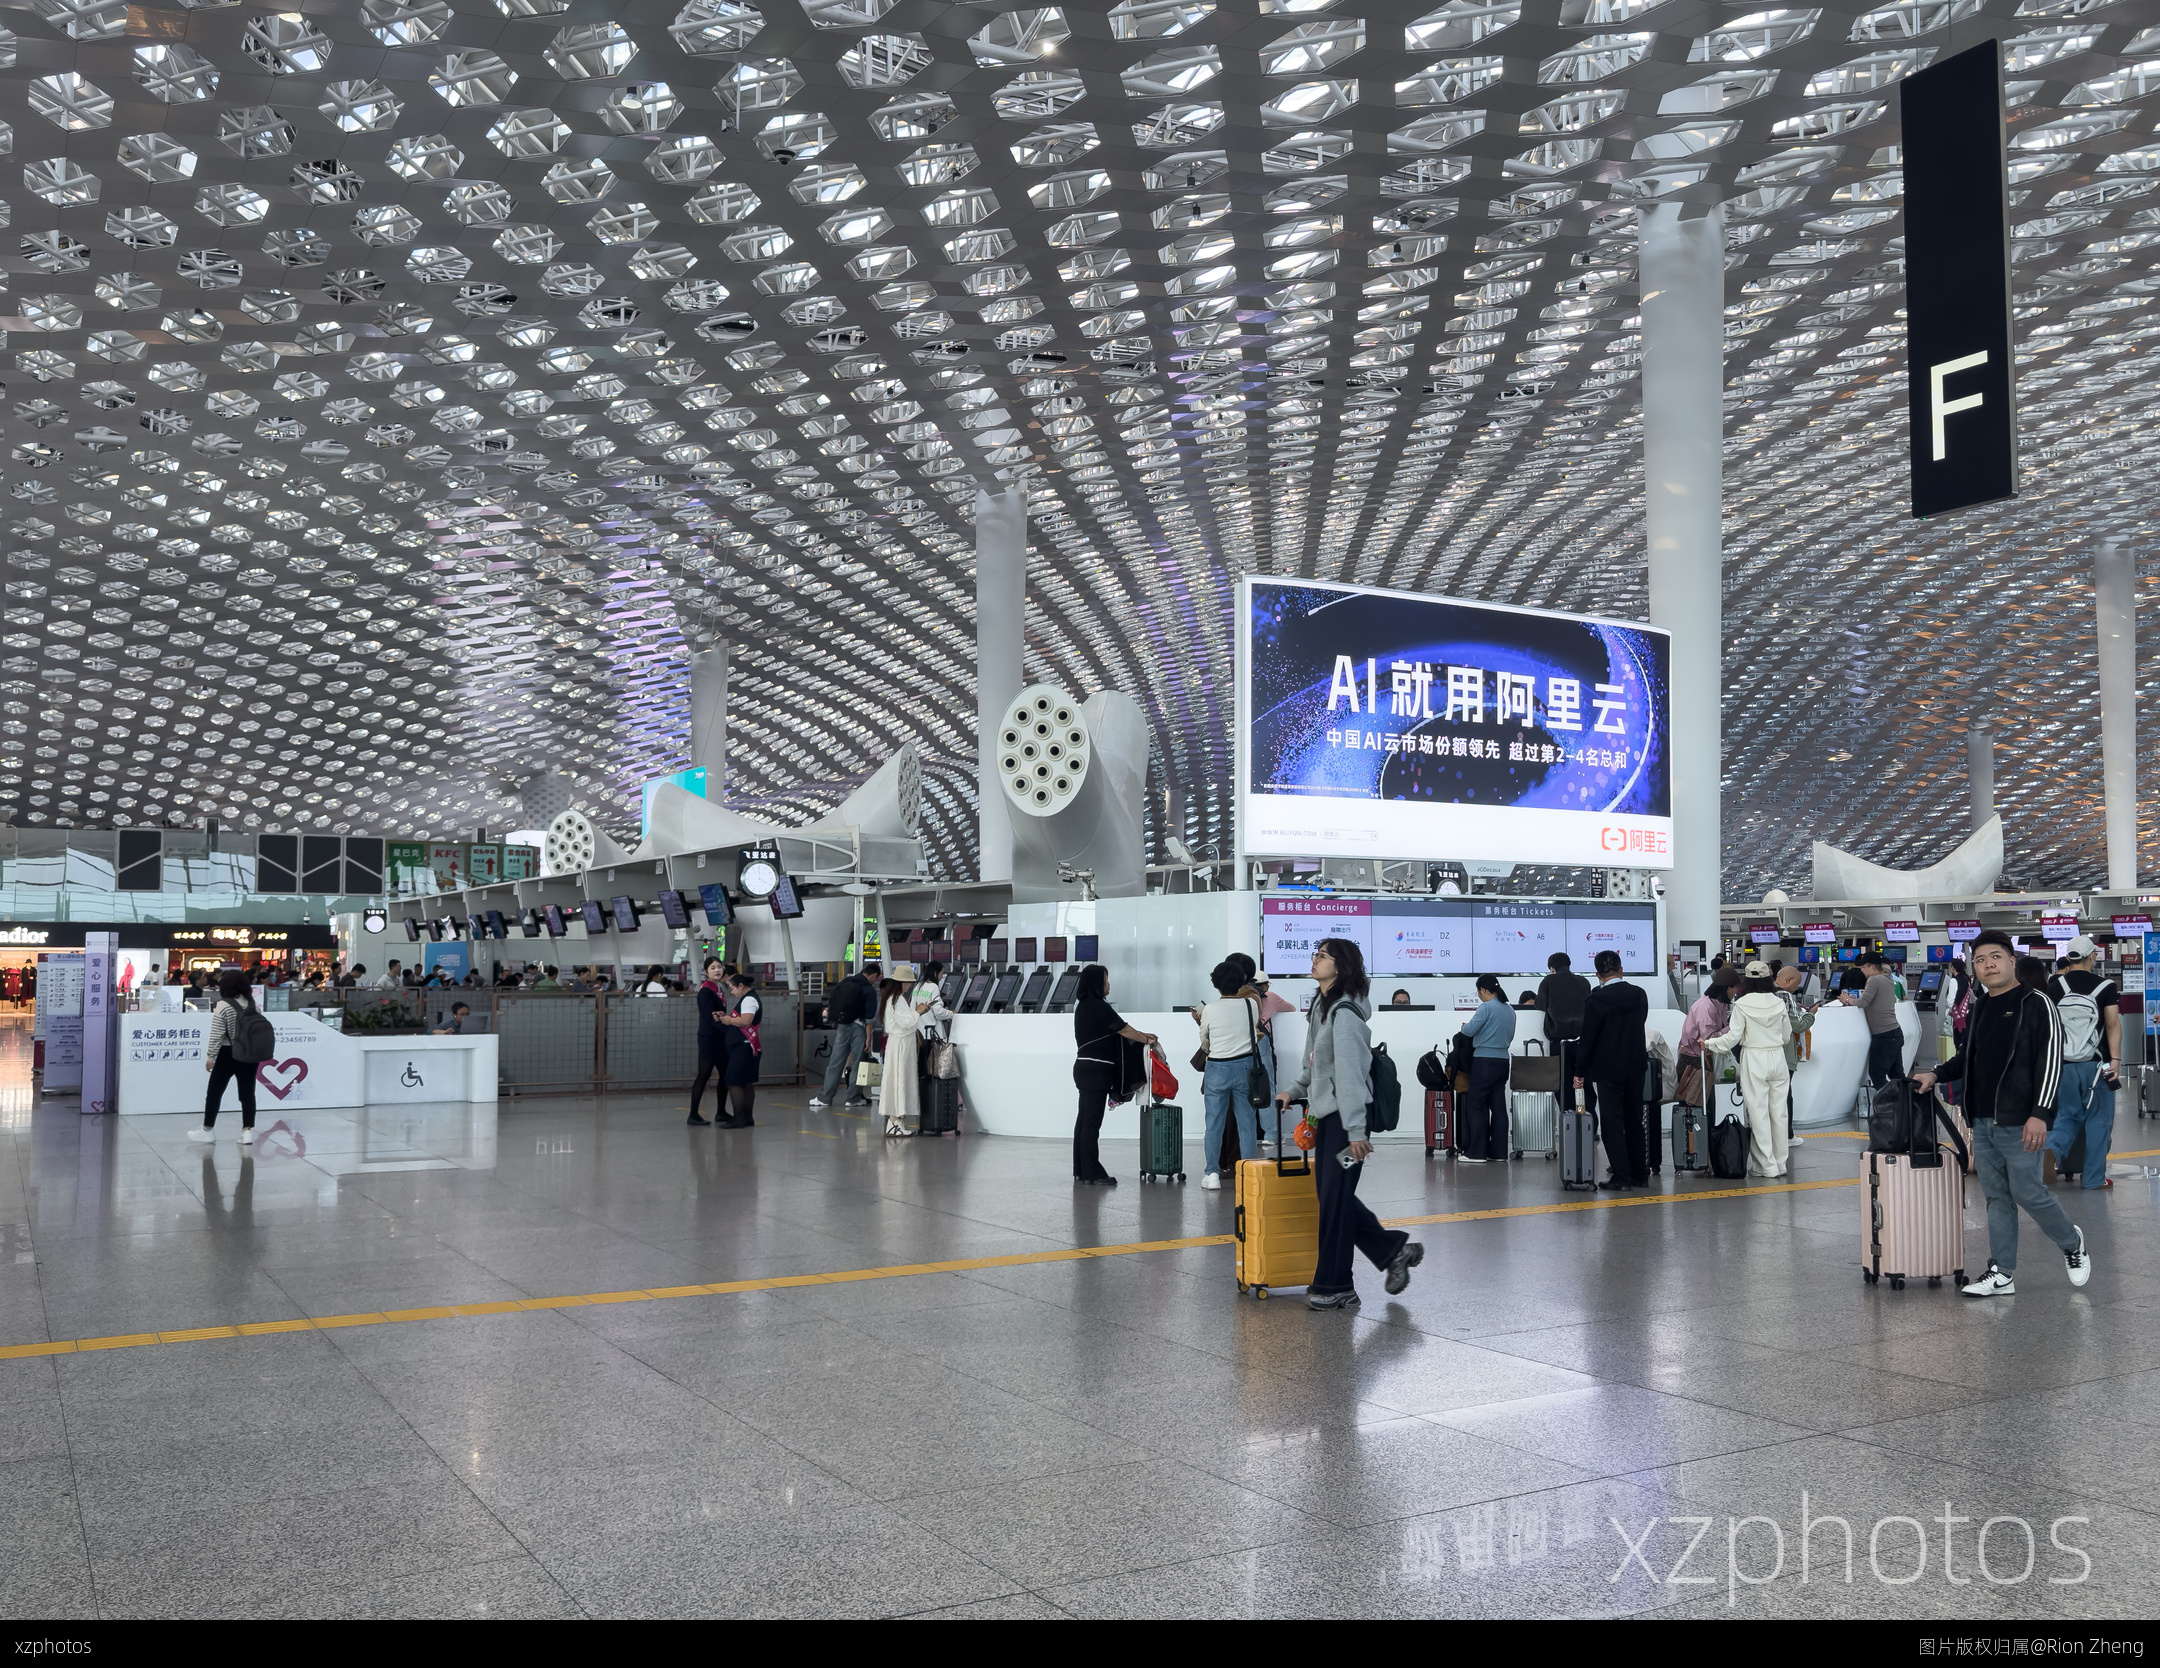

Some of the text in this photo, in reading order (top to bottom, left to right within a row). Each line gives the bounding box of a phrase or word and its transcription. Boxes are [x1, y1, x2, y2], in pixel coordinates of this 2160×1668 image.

[1930, 349, 1988, 462] F
[1327, 654, 1627, 735] AI就用阿里云
[1327, 727, 1501, 760] 中国AI云市场份额领先
[1629, 829, 1667, 854] 阿里云
[393, 848, 420, 857] 星巴克
[434, 849, 460, 858] KFC
[1278, 902, 1358, 913] 服务柜台 Concierge
[1485, 906, 1554, 915] 票务柜台 Tickets
[0, 926, 49, 944] adior
[1440, 931, 1450, 939] DZ
[1440, 949, 1451, 957] DR
[91, 958, 102, 1006] 爱心服务
[132, 1028, 201, 1039] 爱心服务柜台
